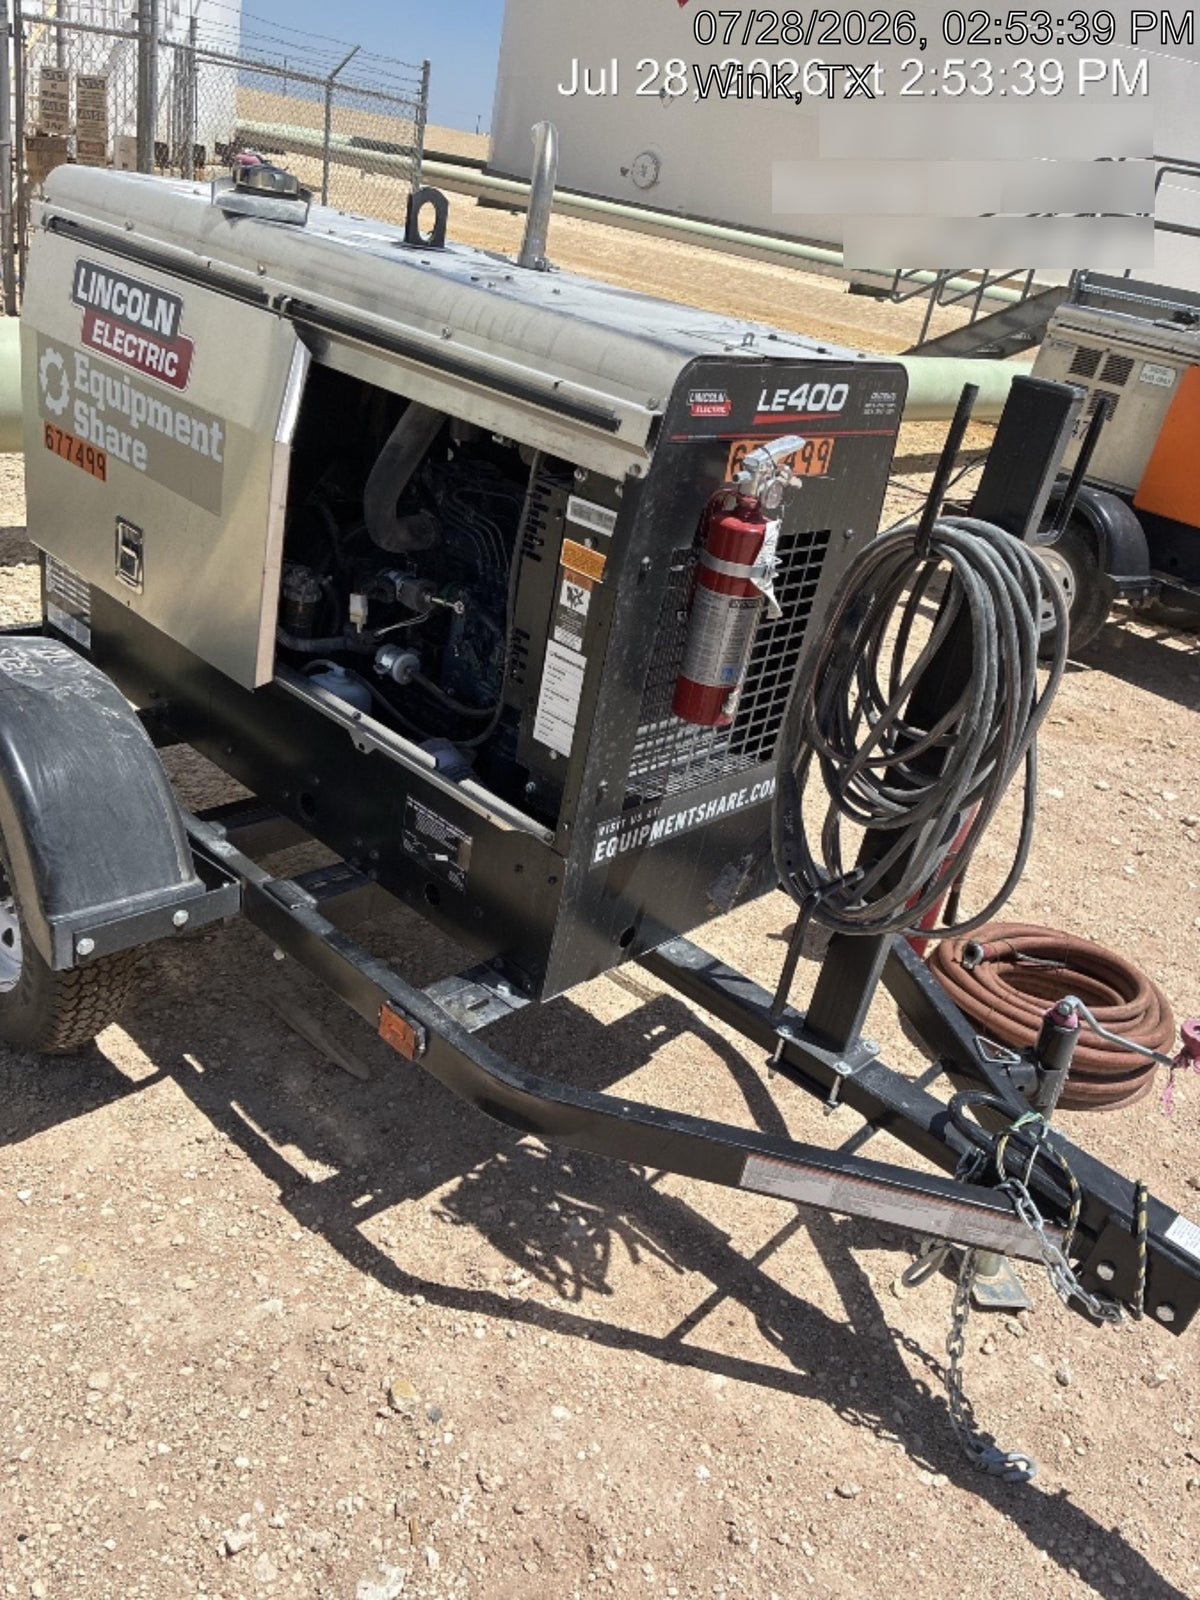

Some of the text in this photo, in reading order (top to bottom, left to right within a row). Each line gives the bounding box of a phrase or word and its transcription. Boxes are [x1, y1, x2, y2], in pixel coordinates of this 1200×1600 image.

[77, 267, 175, 337] LINCOLN
[92, 318, 179, 378] ELECTRIC
[74, 351, 223, 463] Equipment
[757, 383, 849, 411] LE400
[44, 424, 107, 481] 677499
[74, 398, 148, 472] Share
[732, 440, 830, 475] 6499
